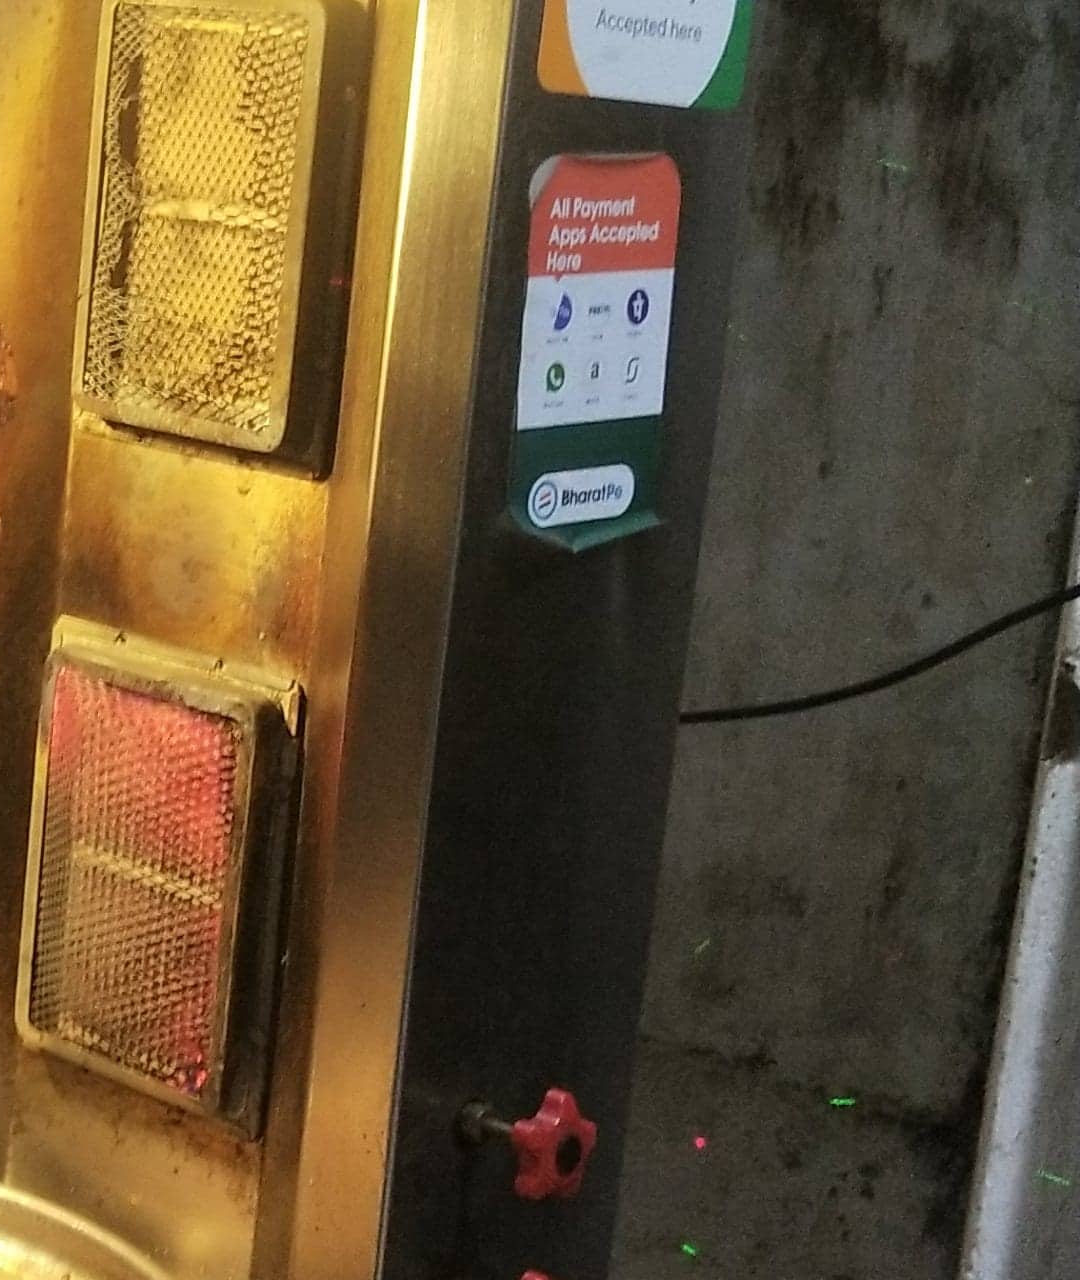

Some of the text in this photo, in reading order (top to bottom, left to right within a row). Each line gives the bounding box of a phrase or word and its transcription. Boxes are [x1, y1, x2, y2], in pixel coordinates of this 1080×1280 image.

[595, 9, 702, 42] Accepted here
[549, 196, 635, 222] All Payment
[548, 221, 660, 249] Apps Accepted
[546, 251, 581, 271] Here
[561, 482, 624, 506] BharatPe
